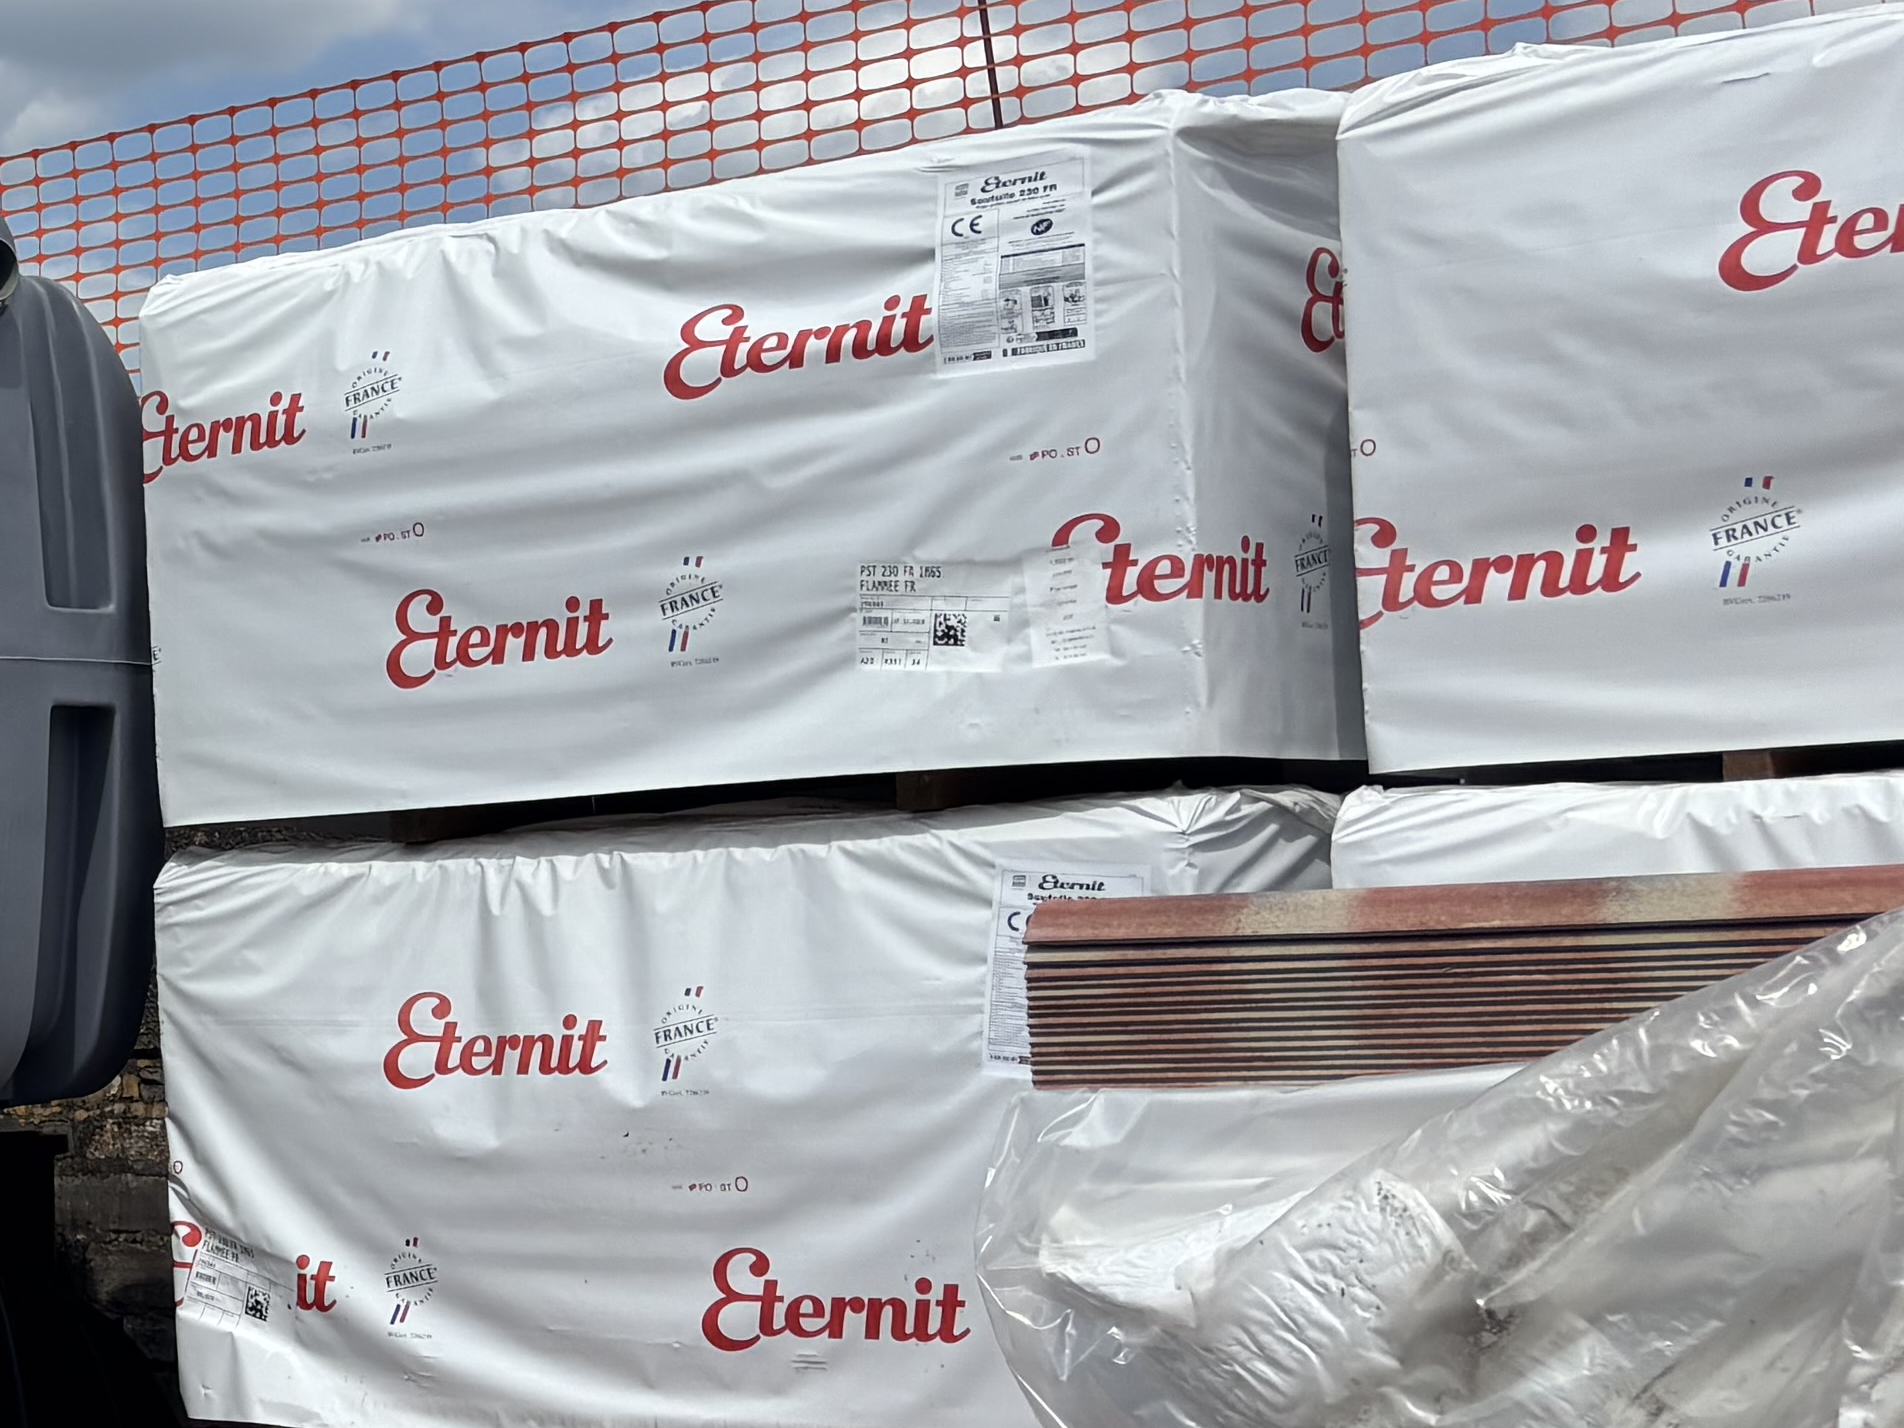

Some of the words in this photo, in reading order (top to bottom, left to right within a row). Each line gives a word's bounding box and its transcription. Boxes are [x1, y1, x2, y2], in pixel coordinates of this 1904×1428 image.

[663, 294, 935, 401] Eternit
[345, 378, 400, 407] FRANCE
[1712, 509, 1797, 546] FRANCE
[660, 585, 721, 616] FRANCE
[386, 588, 614, 689] Eternit
[382, 991, 608, 1090] Eternit
[654, 1017, 715, 1044] FRANCE
[386, 1267, 436, 1288] FRANCE
[700, 1247, 971, 1352] Eternit
